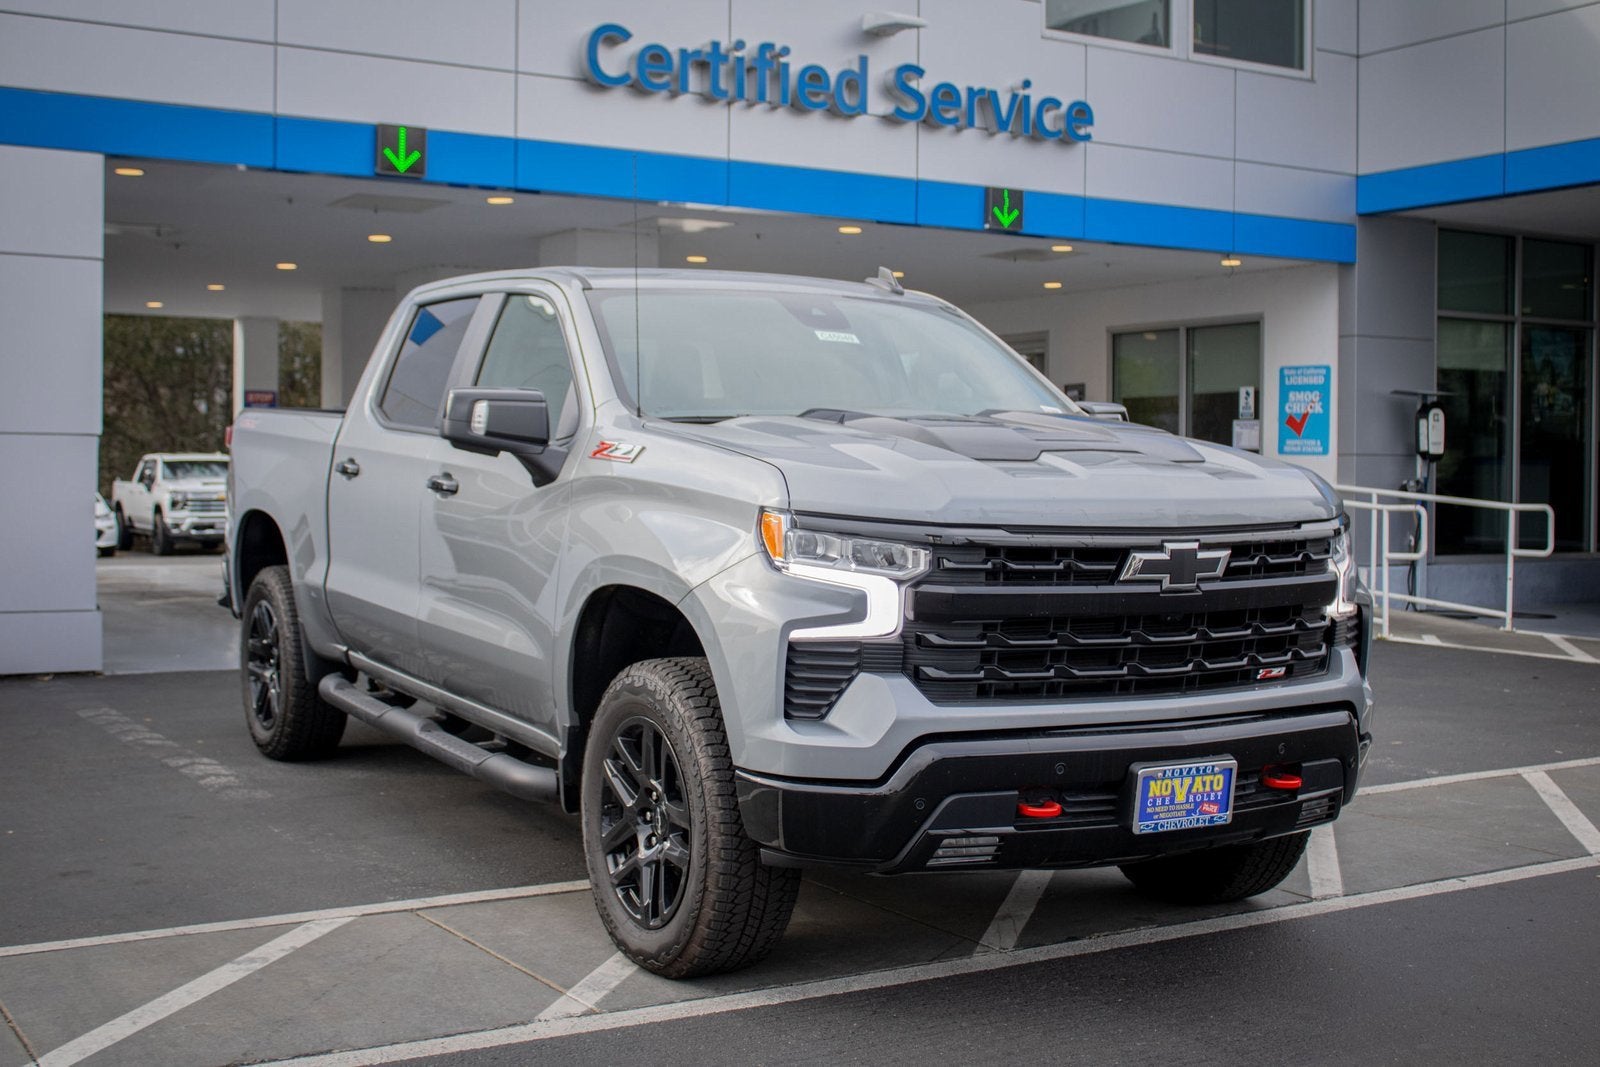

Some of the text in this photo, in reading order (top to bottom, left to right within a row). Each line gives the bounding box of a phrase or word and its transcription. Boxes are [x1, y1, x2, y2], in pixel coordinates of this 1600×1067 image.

[586, 22, 1095, 142] Certified Service
[1285, 375, 1325, 386] LICENSED
[1289, 391, 1320, 402] SMOG
[1285, 402, 1323, 414] CHECK
[1165, 765, 1212, 776] NOVATO
[1149, 774, 1224, 803] NOVATO
[1158, 817, 1210, 830] CHEVROLET
